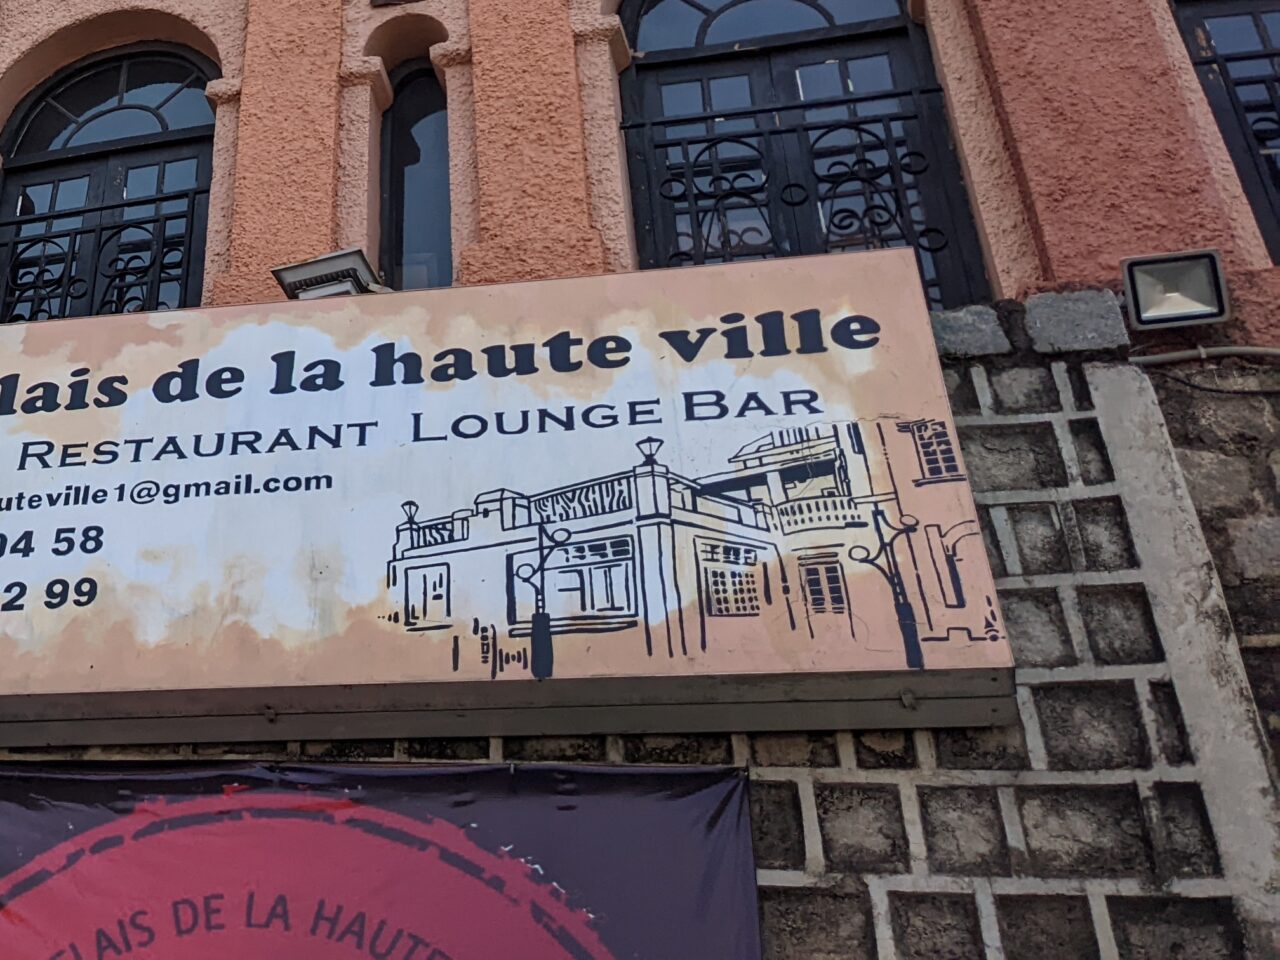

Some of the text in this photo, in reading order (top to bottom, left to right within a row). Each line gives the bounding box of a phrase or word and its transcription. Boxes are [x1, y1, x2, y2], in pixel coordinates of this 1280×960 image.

[152, 357, 244, 404] de
[269, 350, 344, 395] la
[370, 328, 633, 388] haute
[660, 308, 882, 362] ville
[18, 420, 379, 471] RESTAURANT
[411, 397, 662, 442] LOUNGE
[684, 388, 824, 421] BAR
[51, 525, 104, 556] 58
[43, 577, 98, 608] 99
[171, 893, 226, 937] DE
[245, 890, 291, 932] LA
